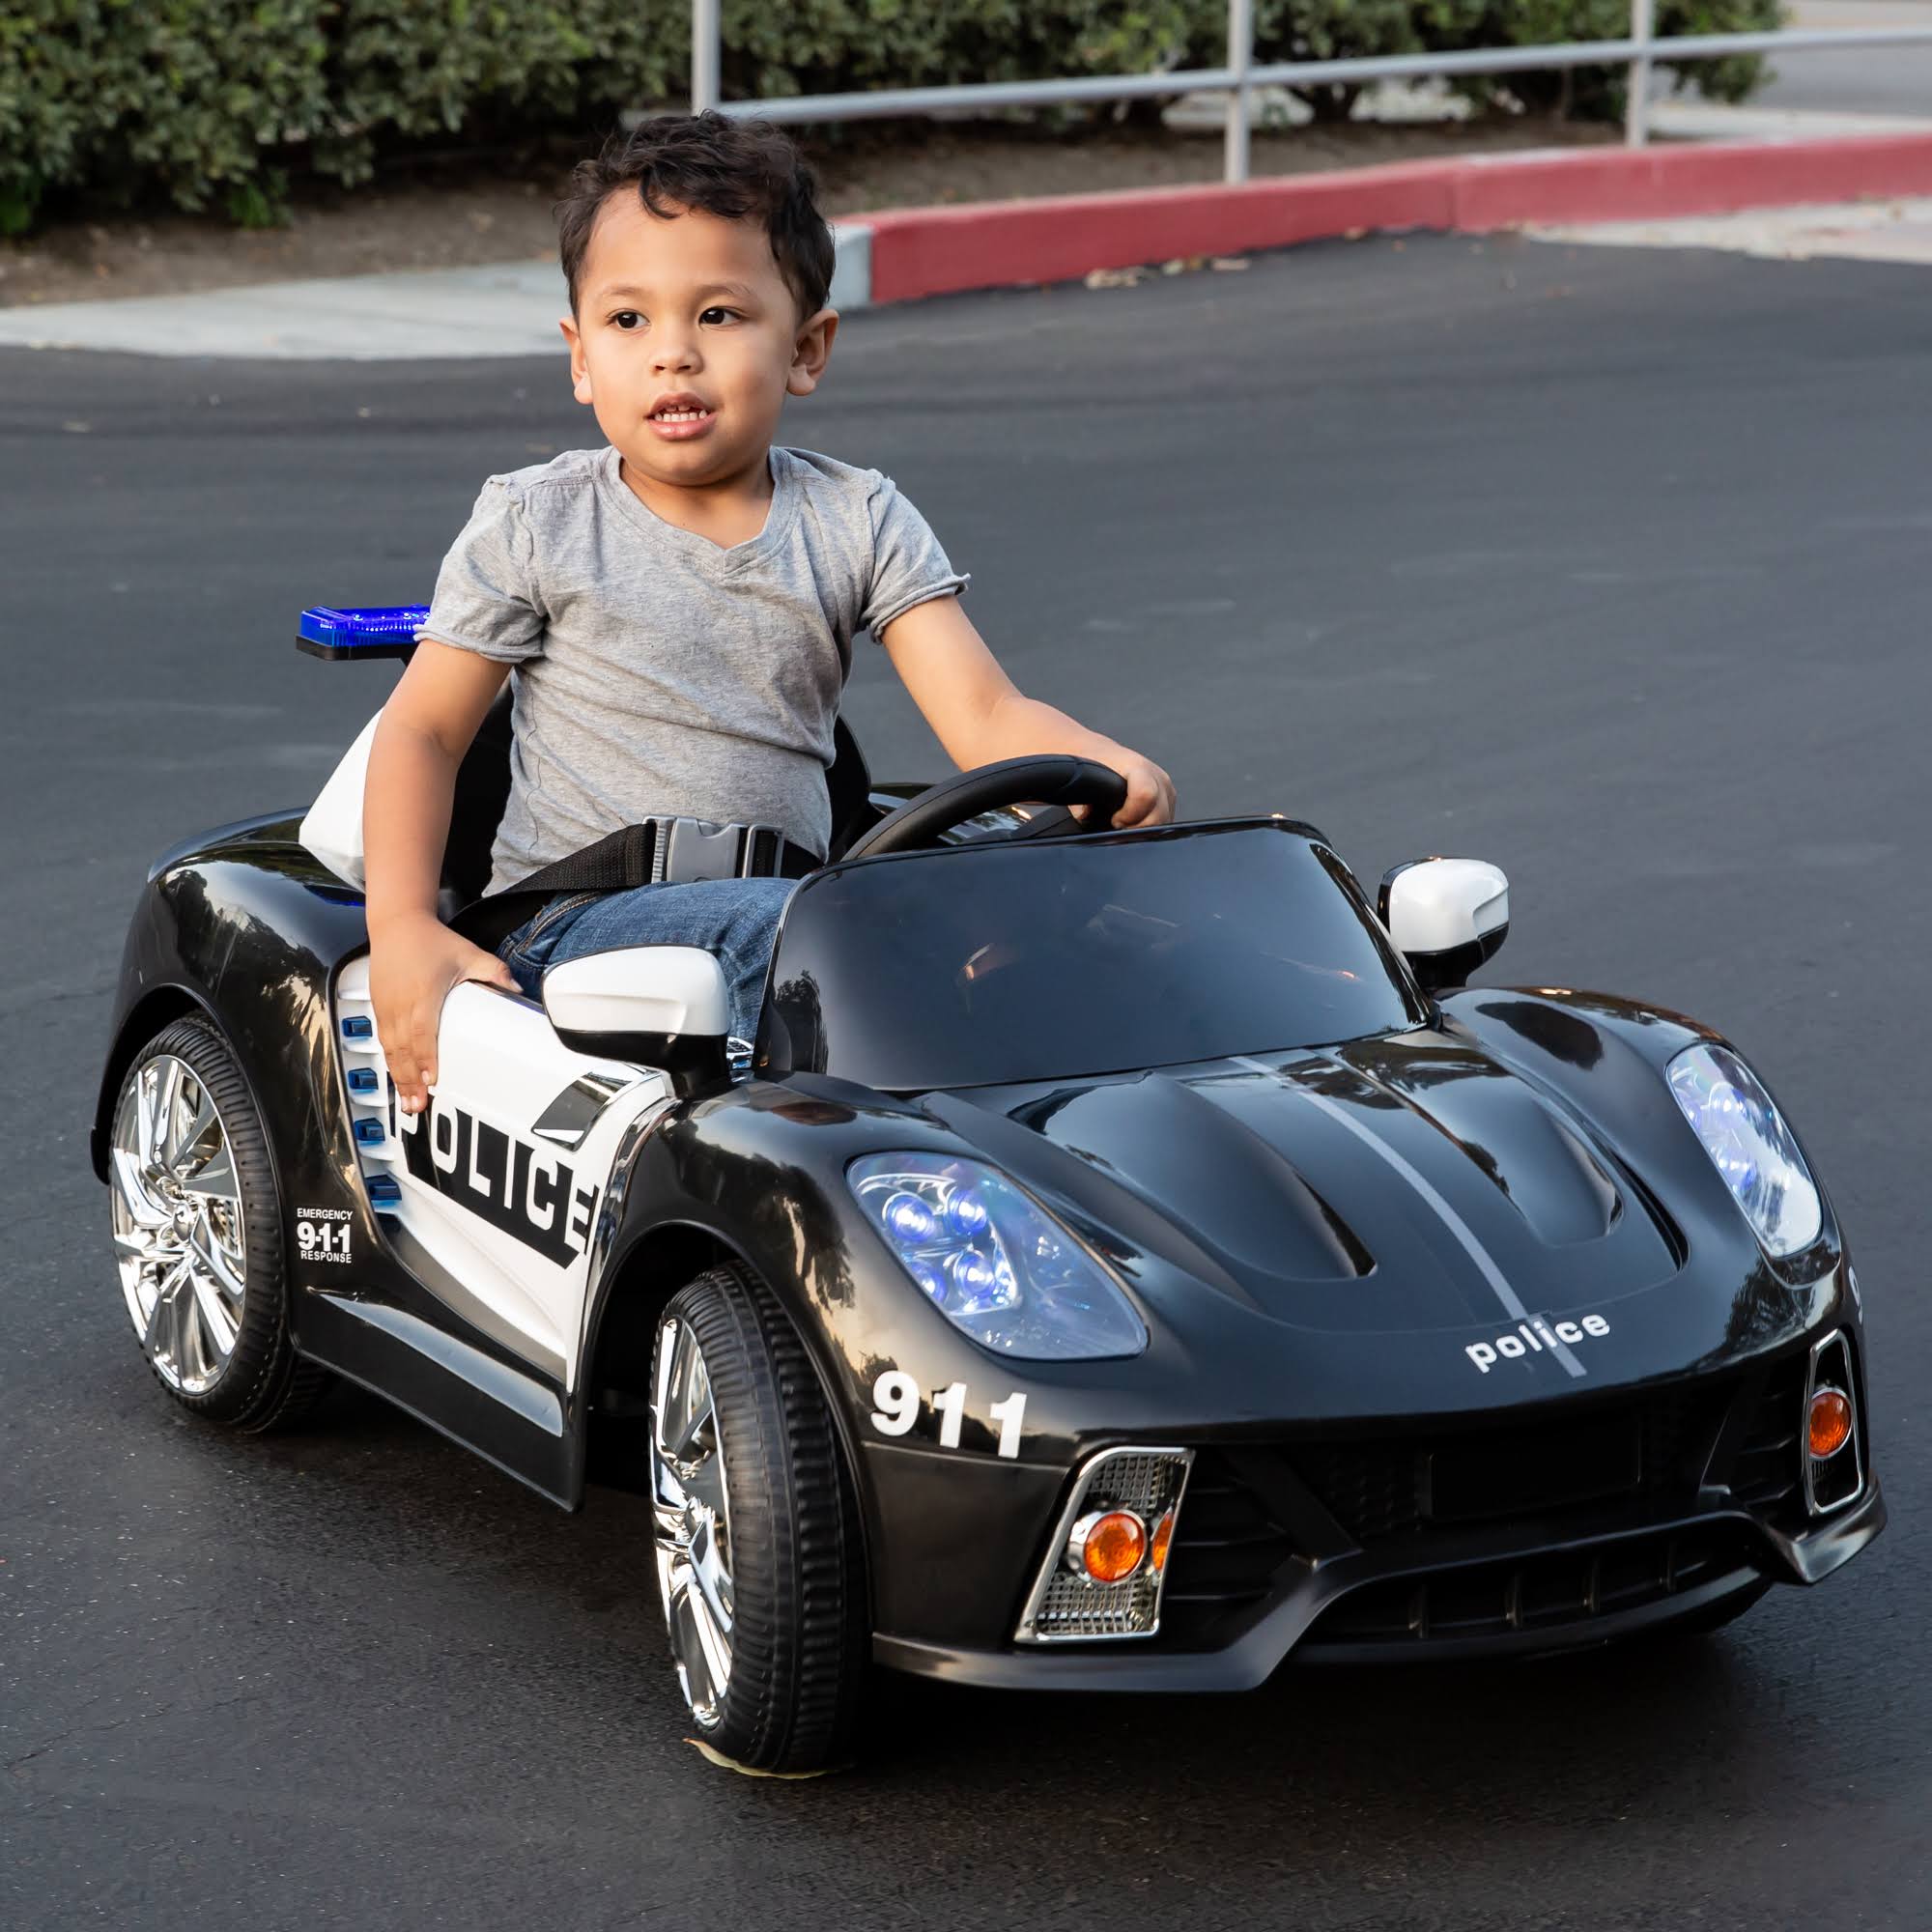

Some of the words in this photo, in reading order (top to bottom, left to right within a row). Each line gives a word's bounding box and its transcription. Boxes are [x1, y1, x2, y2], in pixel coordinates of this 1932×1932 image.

[394, 1082, 597, 1254] POLICE
[297, 1208, 354, 1221] EMERGENCY
[300, 1250, 353, 1264] RESPONSE
[1464, 1314, 1610, 1374] police
[870, 1370, 1028, 1460] 911
